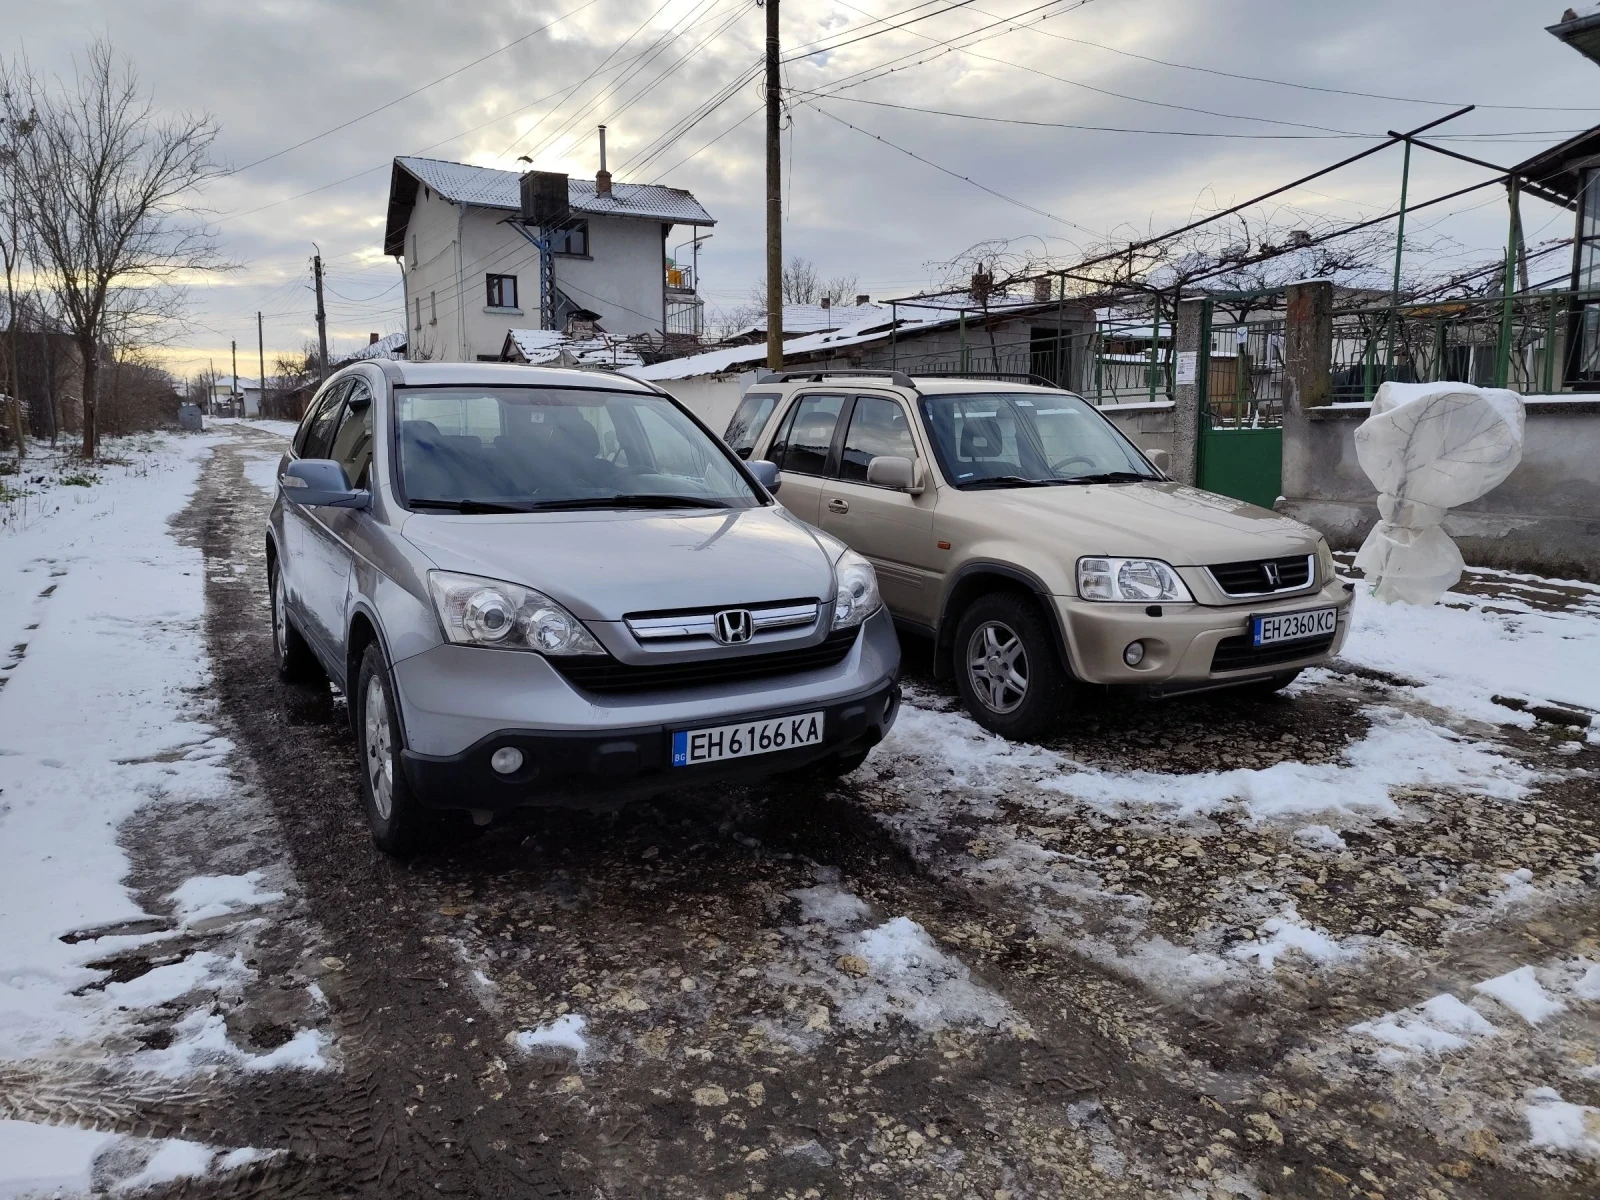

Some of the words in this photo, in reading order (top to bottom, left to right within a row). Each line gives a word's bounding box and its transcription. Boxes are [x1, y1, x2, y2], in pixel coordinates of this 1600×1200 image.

[690, 731, 724, 761] EH
[729, 722, 786, 754] 6166
[791, 716, 819, 745] KA
[674, 753, 686, 762] BG
